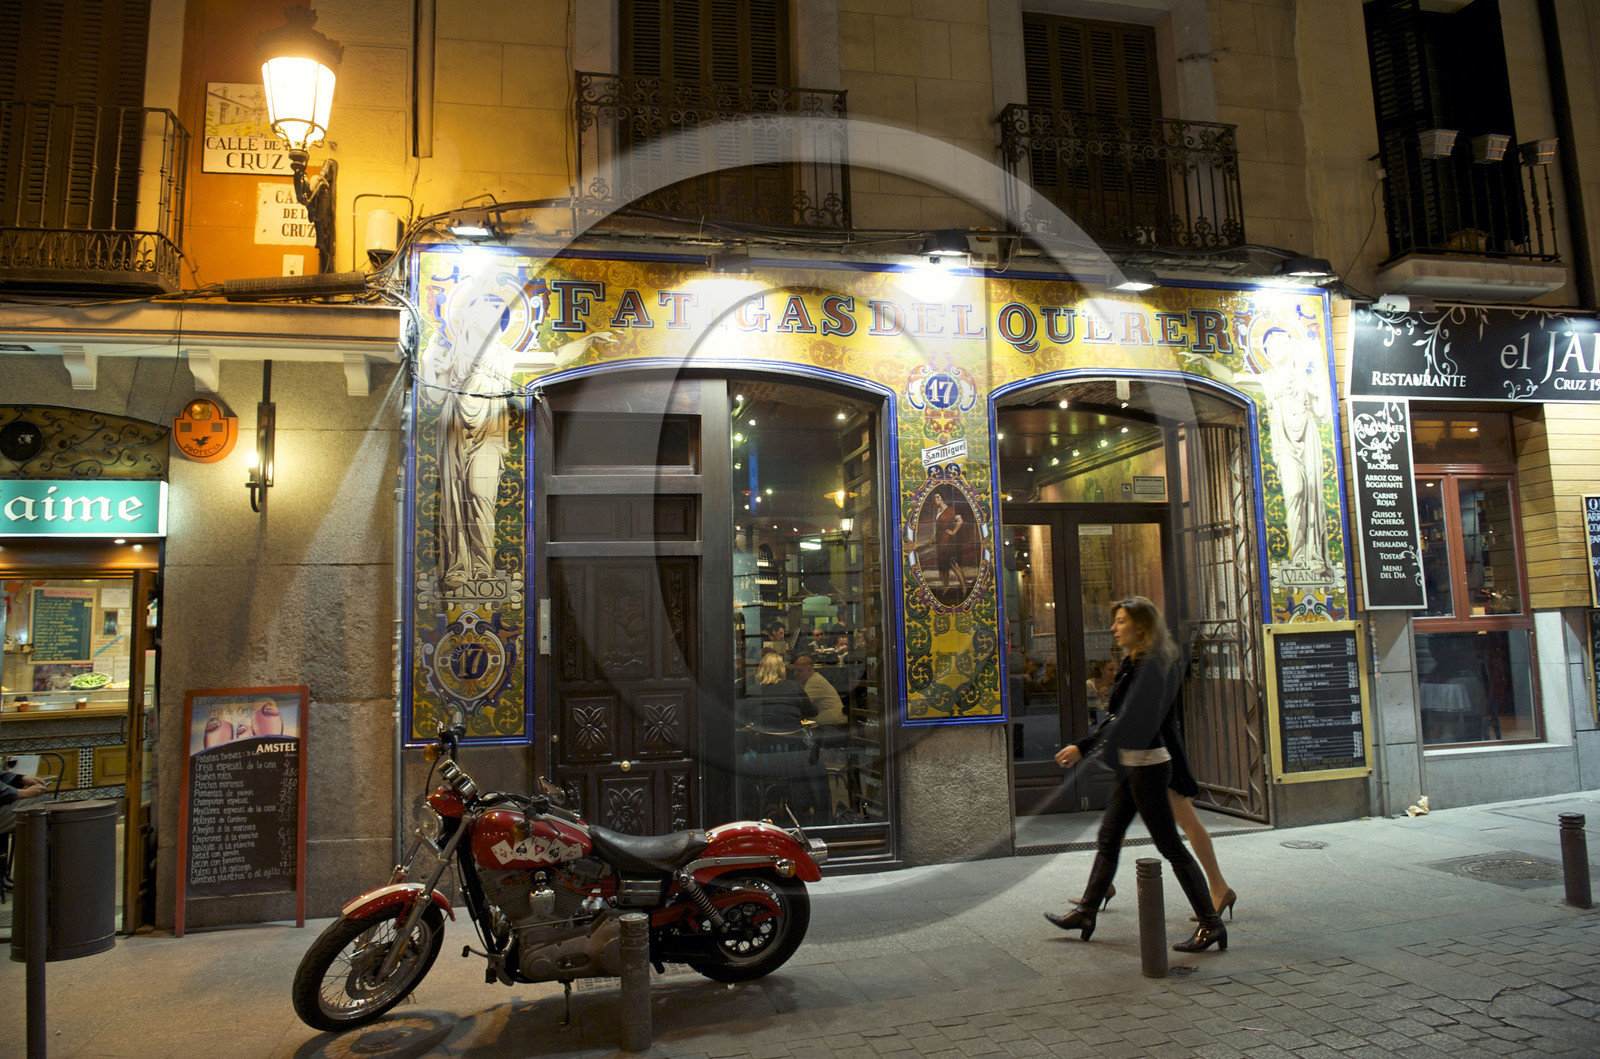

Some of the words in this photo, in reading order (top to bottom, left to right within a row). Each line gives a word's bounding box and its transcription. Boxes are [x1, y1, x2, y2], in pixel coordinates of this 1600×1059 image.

[206, 136, 258, 151] CALLE
[265, 140, 281, 150] DE
[226, 152, 285, 170] CRUZ
[283, 208, 298, 219] DE
[281, 223, 317, 238] CRUZ
[867, 299, 987, 340] DEL
[997, 302, 1234, 354] QUERER
[1371, 371, 1466, 388] RESTAURANTE
[1553, 377, 1587, 391] CRUZ
[928, 378, 954, 404] 17
[1367, 462, 1399, 471] RACIONES
[1365, 474, 1387, 482] ARROZ
[1365, 481, 1404, 489] BOGAVANTE
[1372, 491, 1398, 500] CARNES
[3, 485, 144, 523] aime
[1376, 500, 1396, 508] ROJAS
[1372, 510, 1397, 518] GUISOS
[1370, 517, 1405, 525] PUCHEROS
[1369, 529, 1409, 537] CARPACCIOS
[1372, 540, 1408, 548] ENSALADAS
[1379, 552, 1403, 560] TOSTAS
[451, 643, 473, 662] CRUZ
[456, 648, 485, 677] 17
[256, 742, 297, 754] AMSTEL
